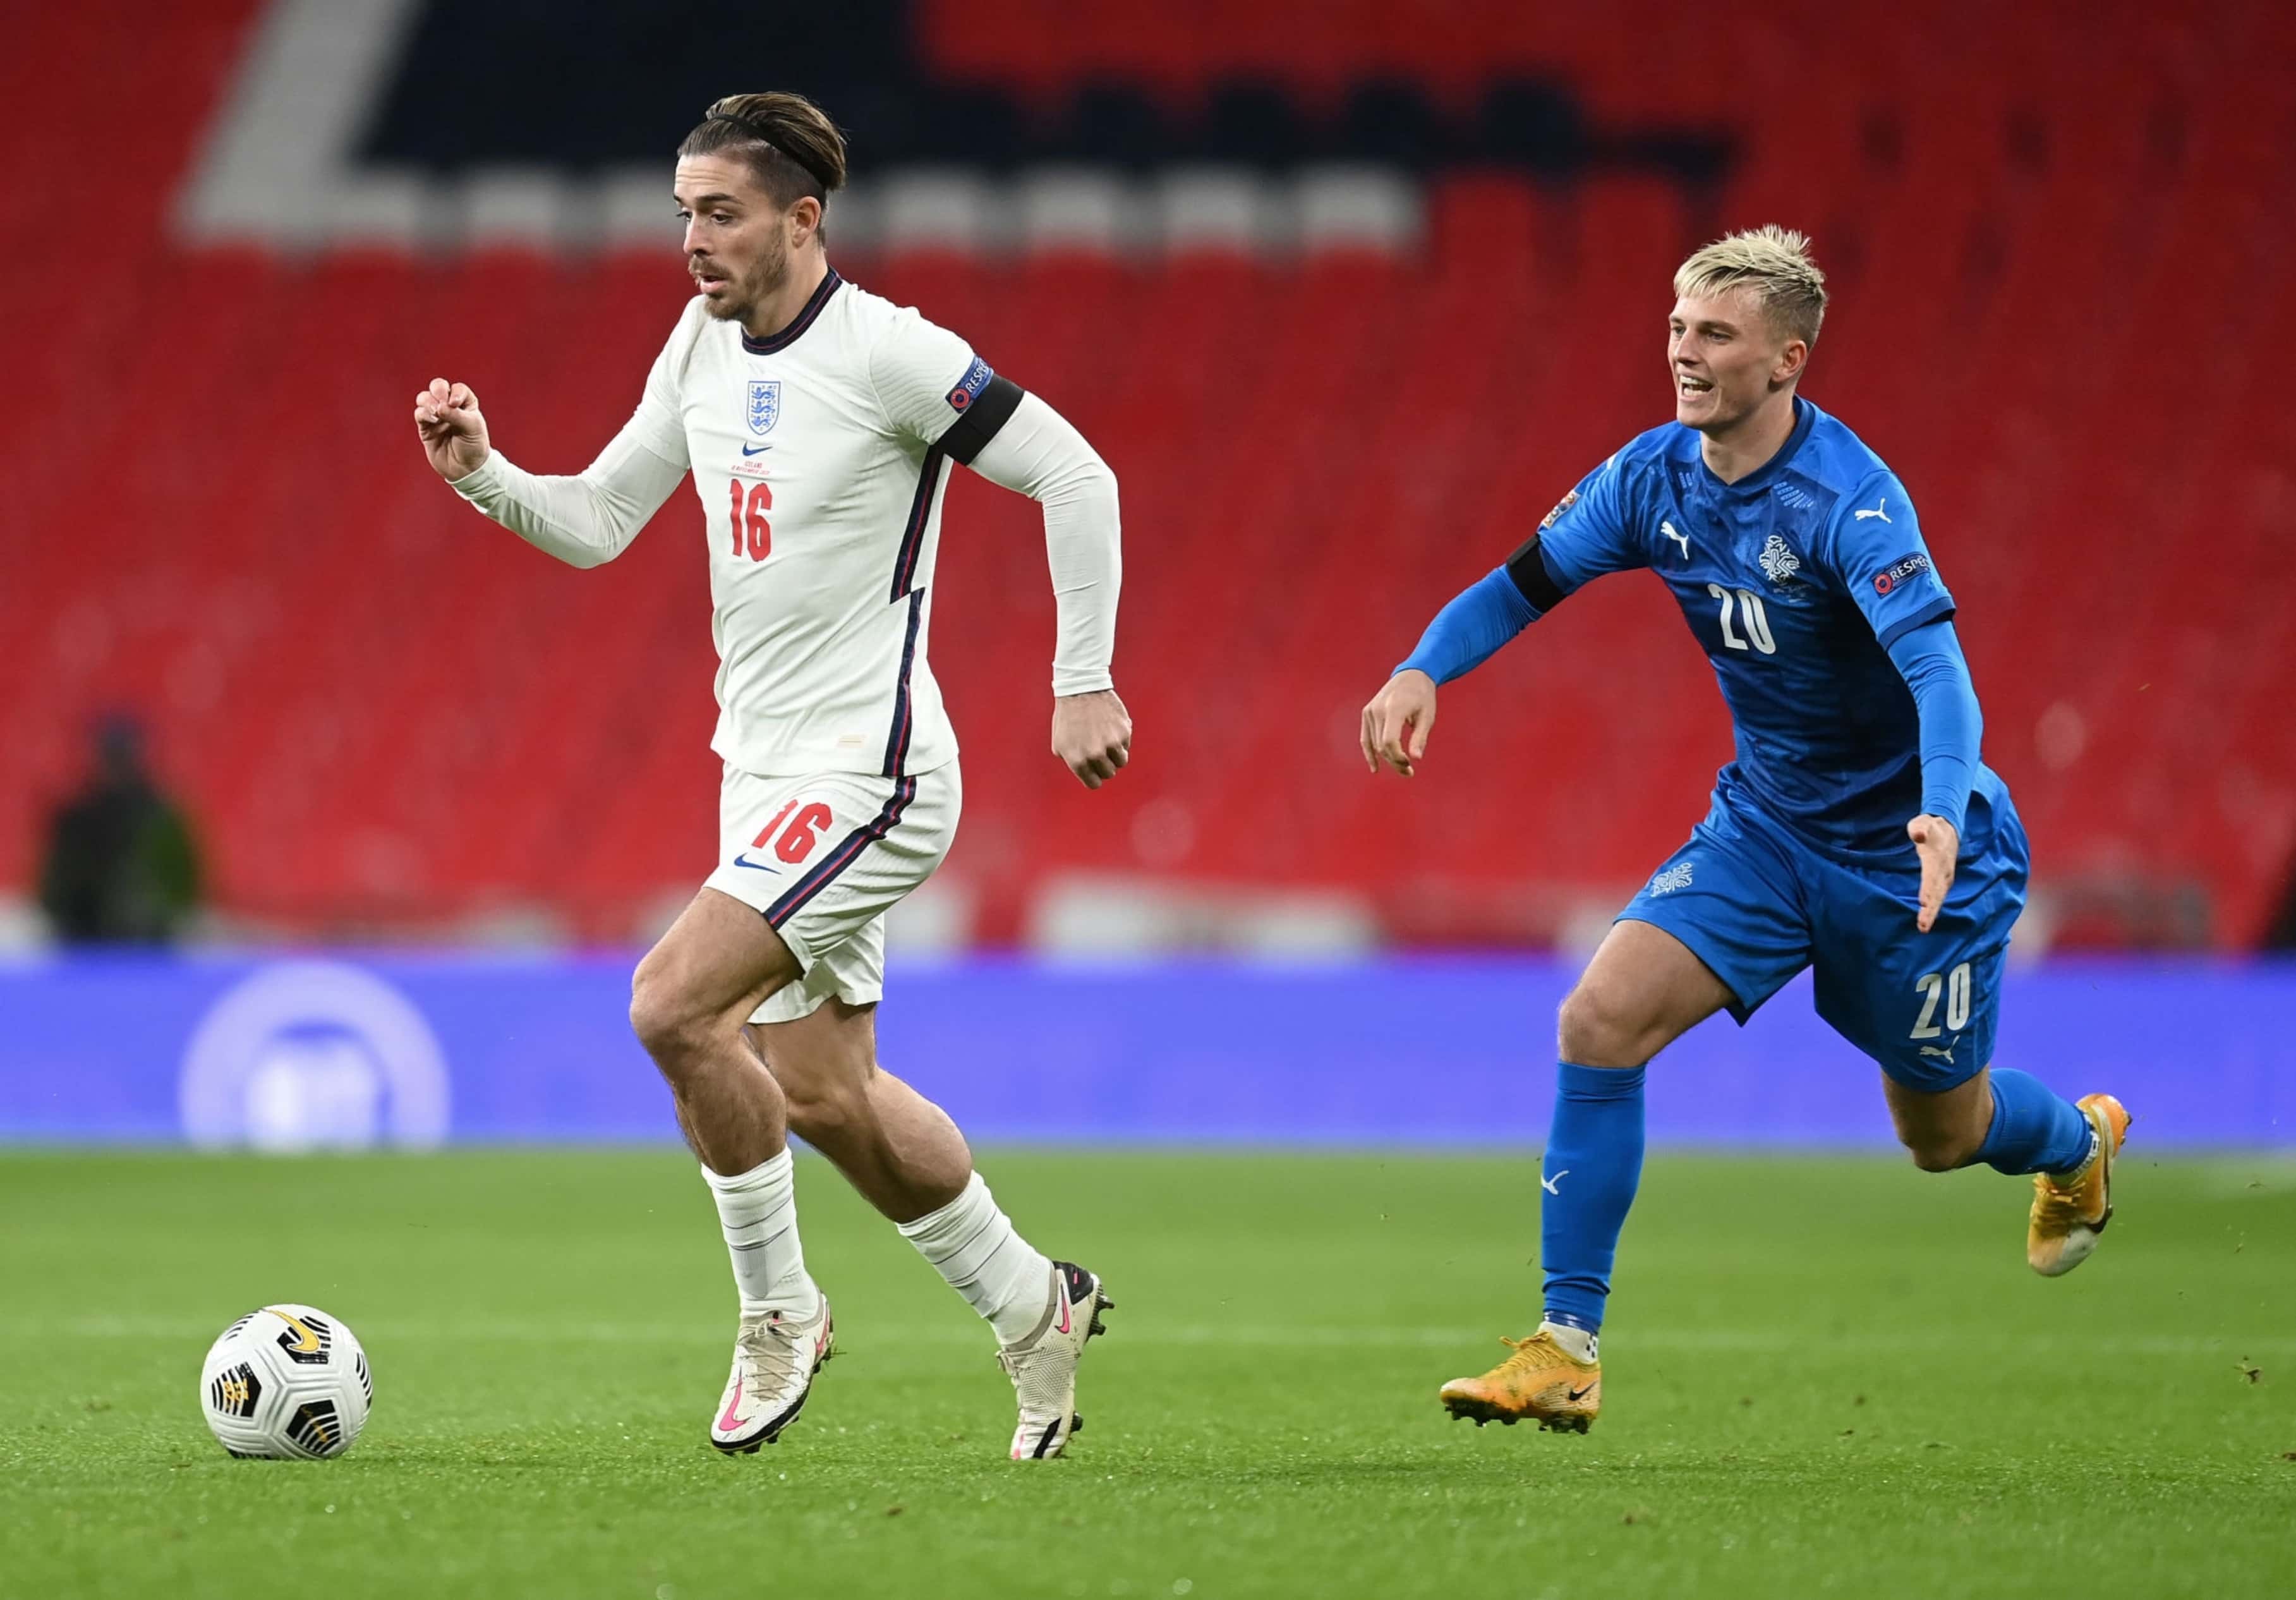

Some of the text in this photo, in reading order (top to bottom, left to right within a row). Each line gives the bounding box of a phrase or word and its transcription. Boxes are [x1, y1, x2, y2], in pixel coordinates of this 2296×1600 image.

[730, 478, 772, 562] 16
[1707, 583, 1777, 654] 20
[751, 799, 833, 864] 16
[1909, 962, 1970, 1038] 20
